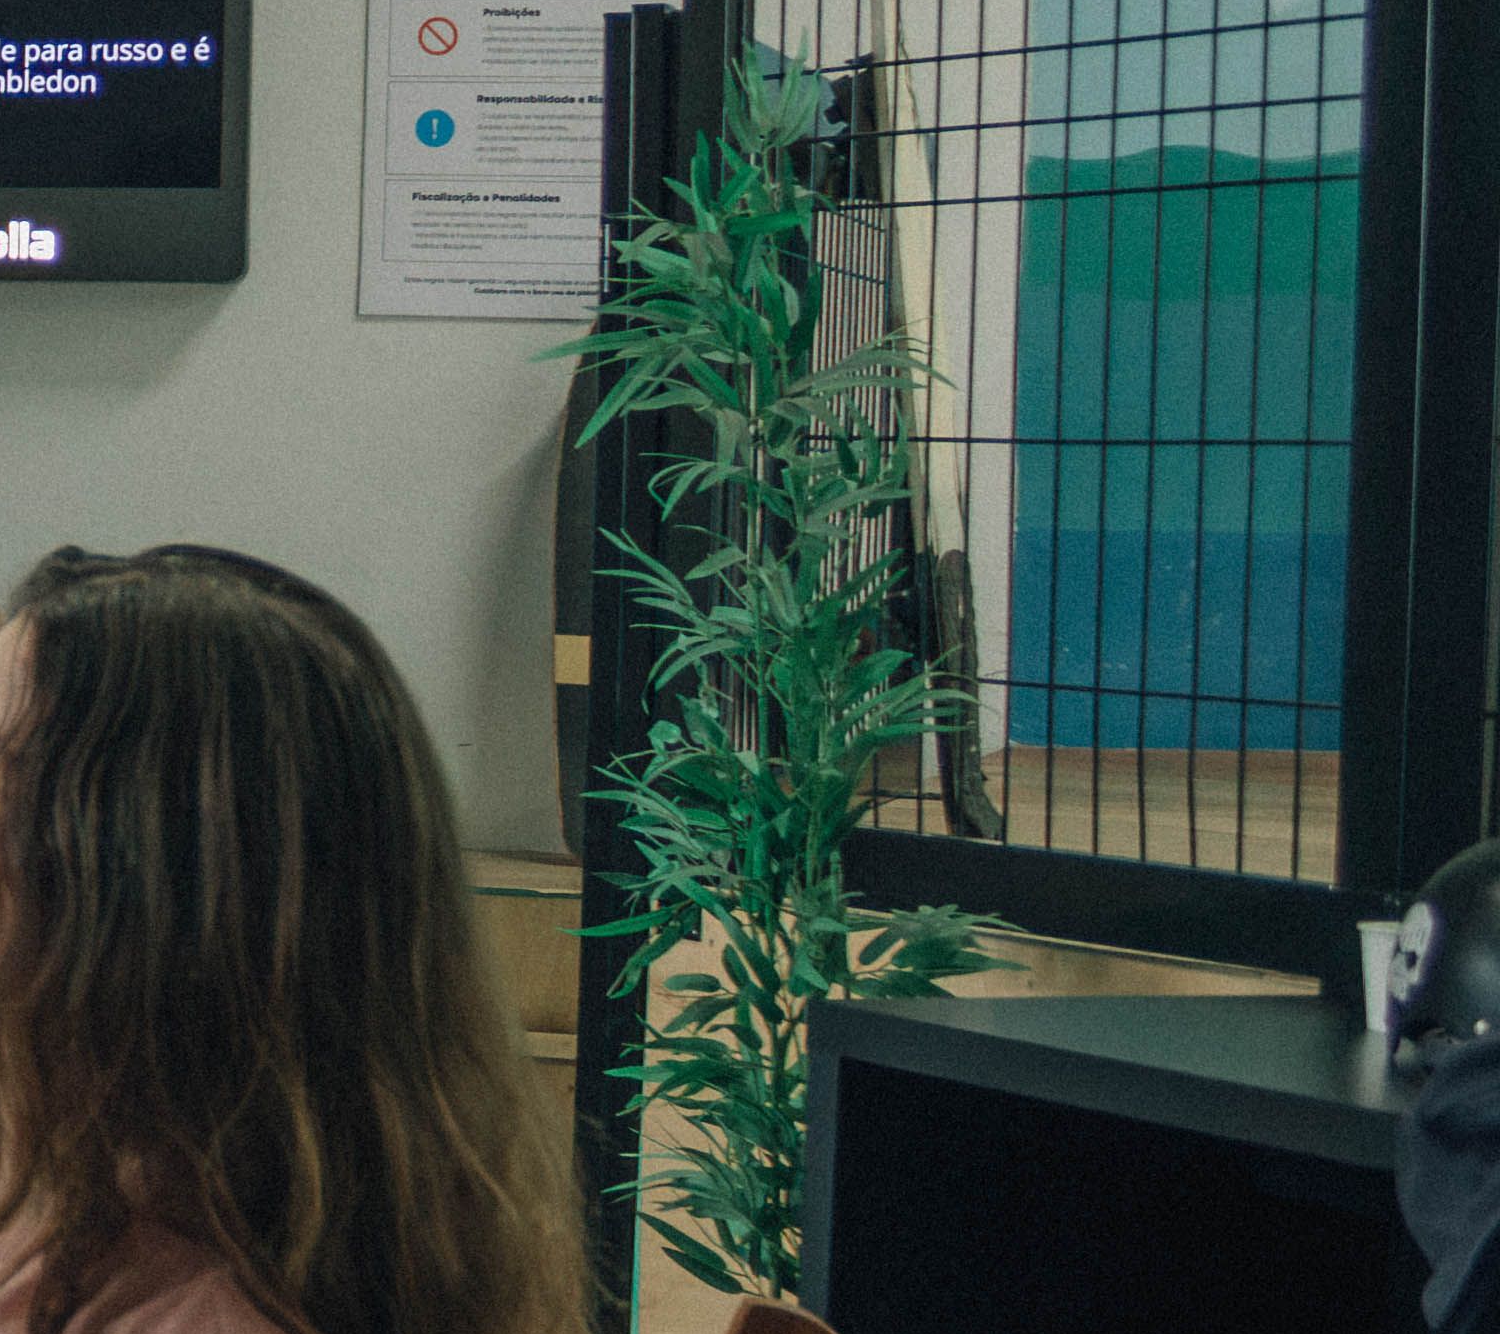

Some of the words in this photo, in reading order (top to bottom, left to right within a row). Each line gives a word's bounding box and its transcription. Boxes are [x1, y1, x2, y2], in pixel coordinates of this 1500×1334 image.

[483, 7, 541, 19] Proibições
[24, 43, 83, 69] para
[90, 42, 164, 63] russo
[170, 42, 188, 62] e
[193, 36, 211, 61] é
[476, 94, 576, 106] Responsabilidade
[411, 191, 481, 204] Fiscalização
[492, 192, 560, 203] Penalidades
